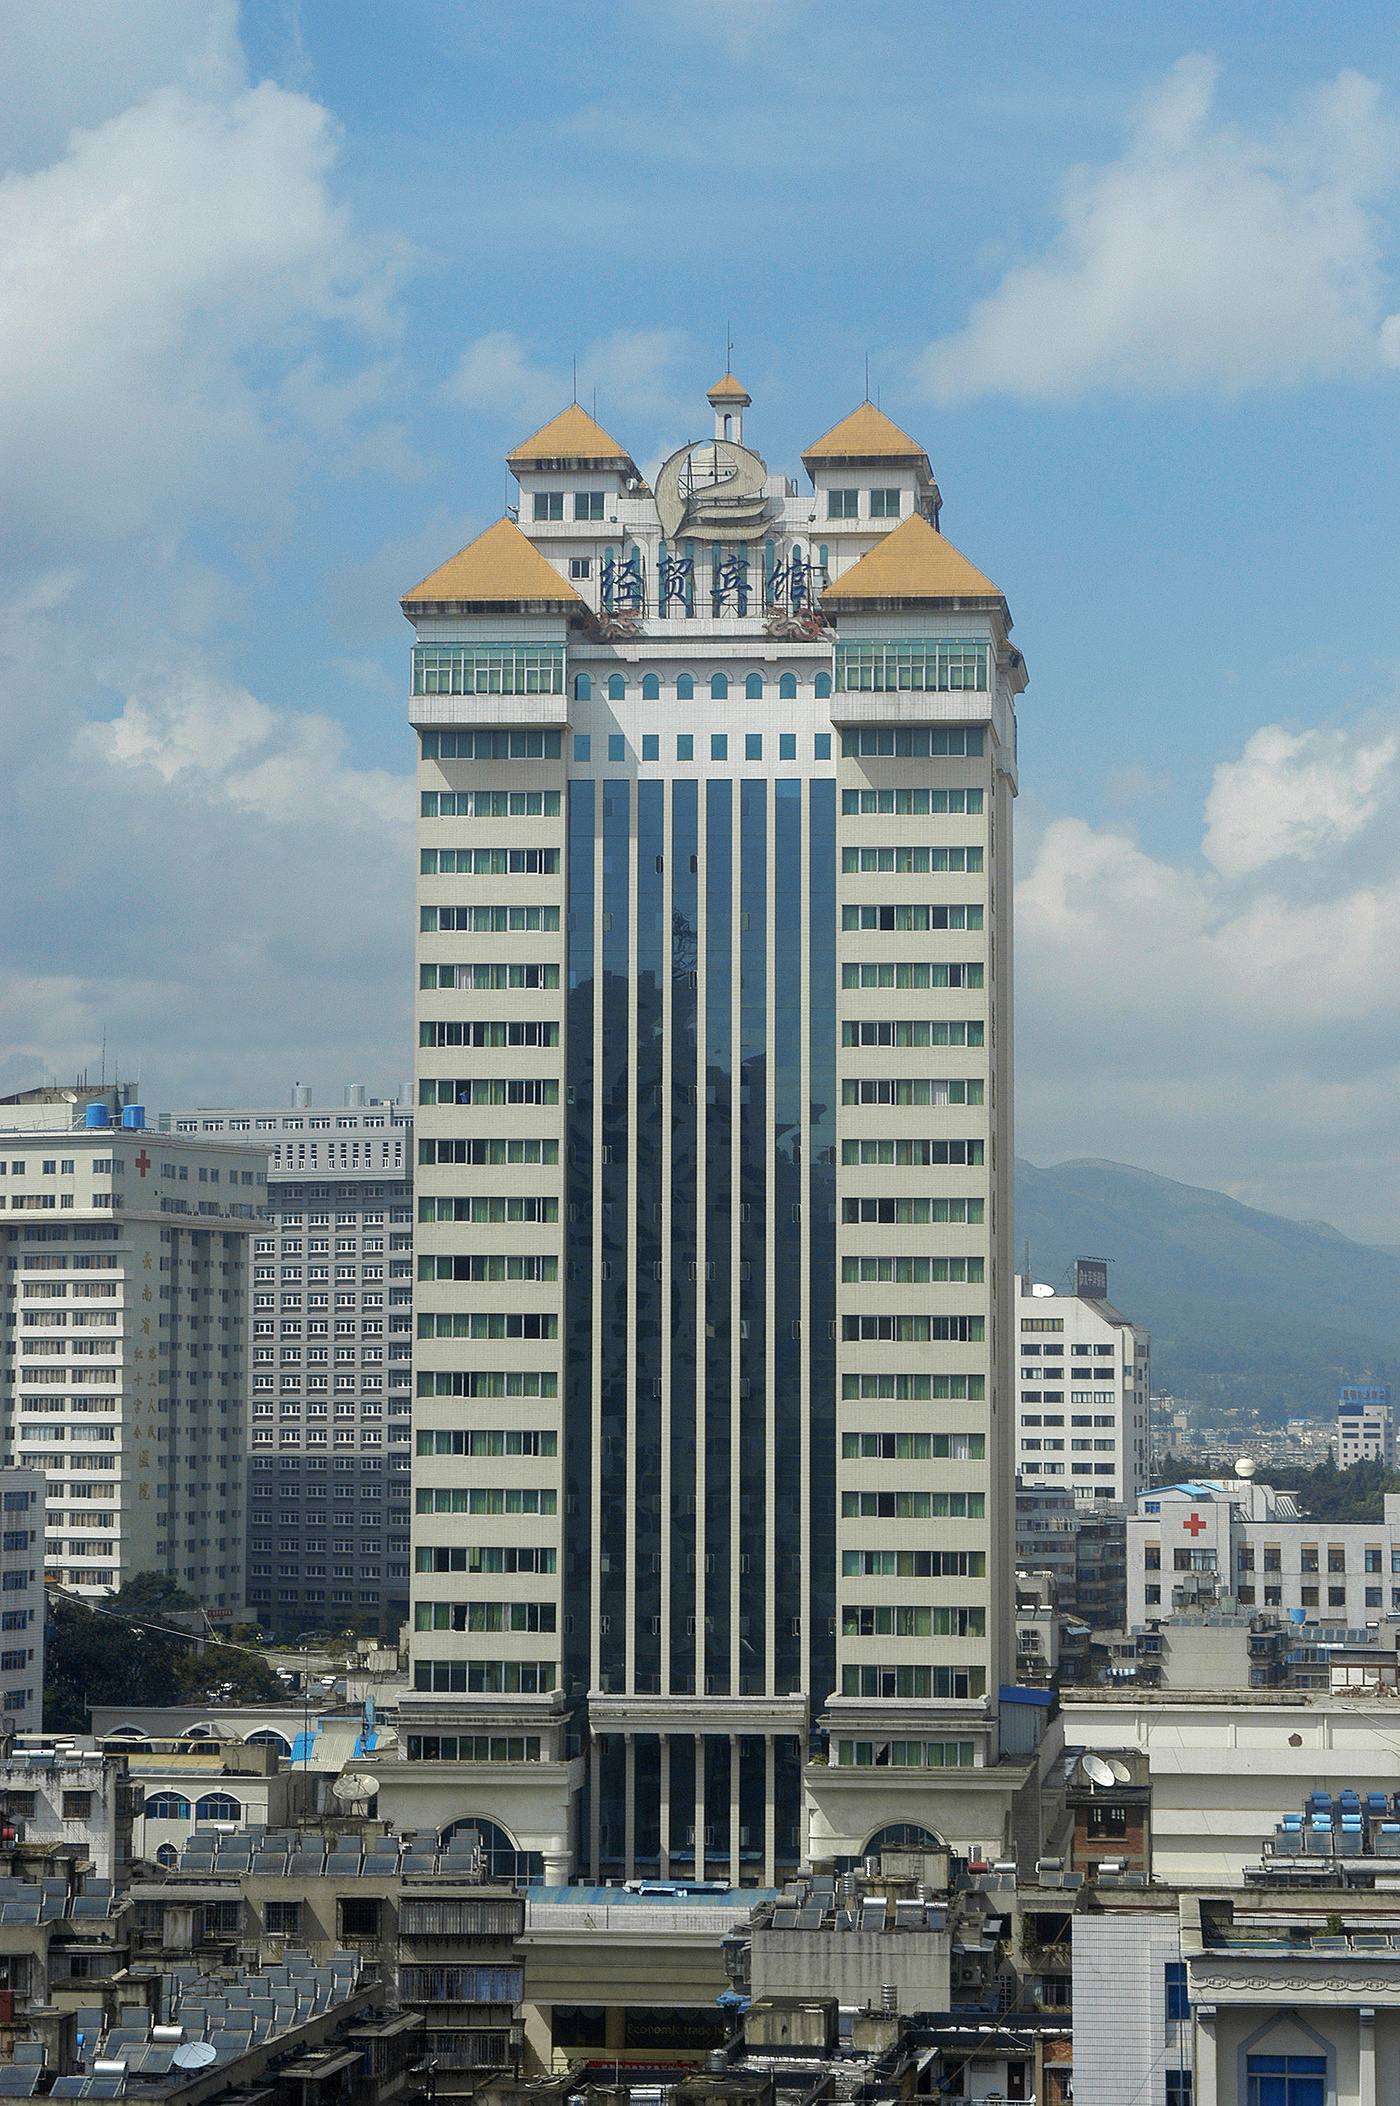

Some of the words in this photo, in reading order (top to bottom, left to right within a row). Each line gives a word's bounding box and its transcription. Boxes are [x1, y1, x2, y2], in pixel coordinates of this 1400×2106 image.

[600, 554, 811, 605] 经贸宾馆
[627, 2023, 680, 2035] Economic
